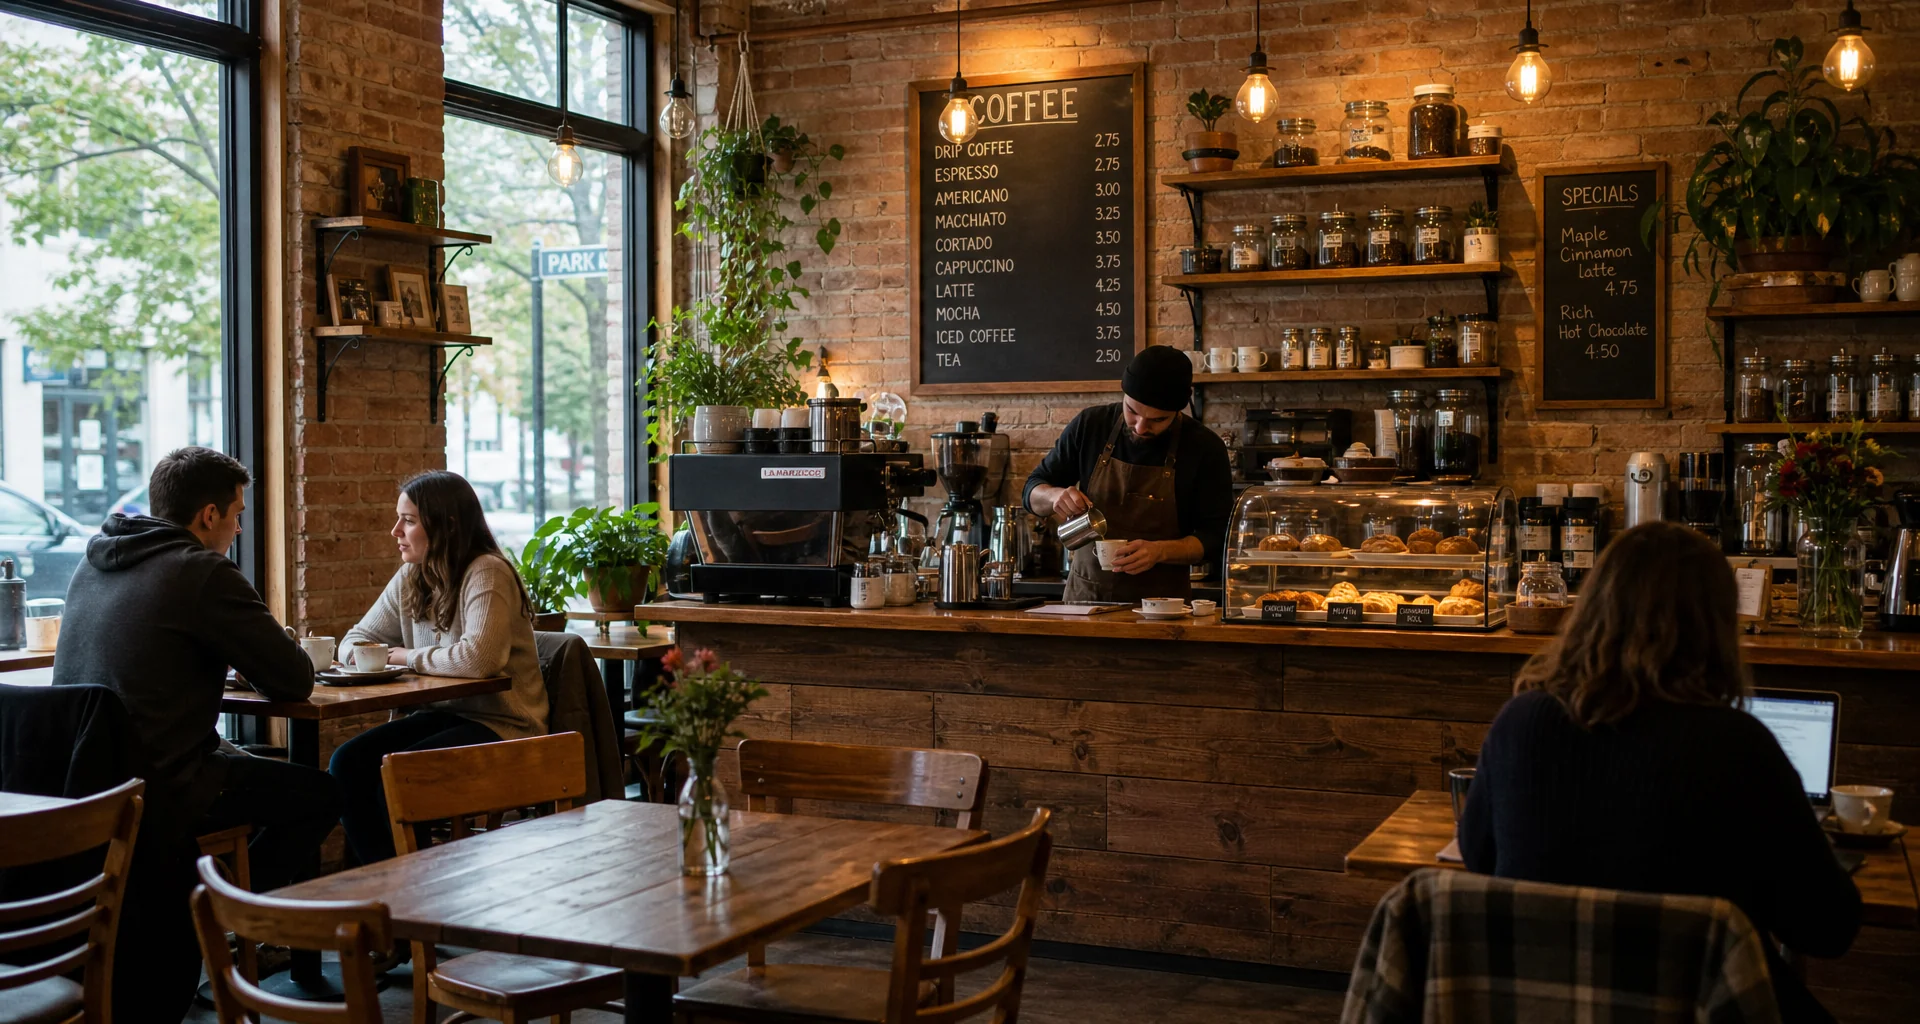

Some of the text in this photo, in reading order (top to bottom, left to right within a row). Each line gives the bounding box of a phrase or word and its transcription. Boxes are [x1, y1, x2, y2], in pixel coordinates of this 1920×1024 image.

[969, 87, 1078, 124] COFFEE
[935, 132, 1120, 160] DRIP COFFEE 2.75
[935, 157, 1120, 182] ESPRESSO 2.75
[935, 182, 1120, 206] AMERICANO 3.00
[1562, 184, 1639, 206] SPECIALS
[935, 206, 1121, 229] MACCHIATO 3.25
[935, 230, 1121, 252] CORTADO 3.50
[1561, 225, 1608, 248] Maple
[548, 251, 596, 273] PARK
[935, 254, 1121, 275] CAPPUCCINO 3.75
[1560, 246, 1633, 263] Cinnamon
[936, 277, 1121, 298] LATTE 4.25
[1604, 280, 1638, 297] 4.75
[936, 302, 1121, 321] MOCHA 4.50
[1560, 304, 1594, 320] Rich
[936, 325, 1121, 344] ICED COFFEE 3.75
[1558, 321, 1649, 339] Hot Chocolate
[936, 349, 1121, 367] TEA 2.50
